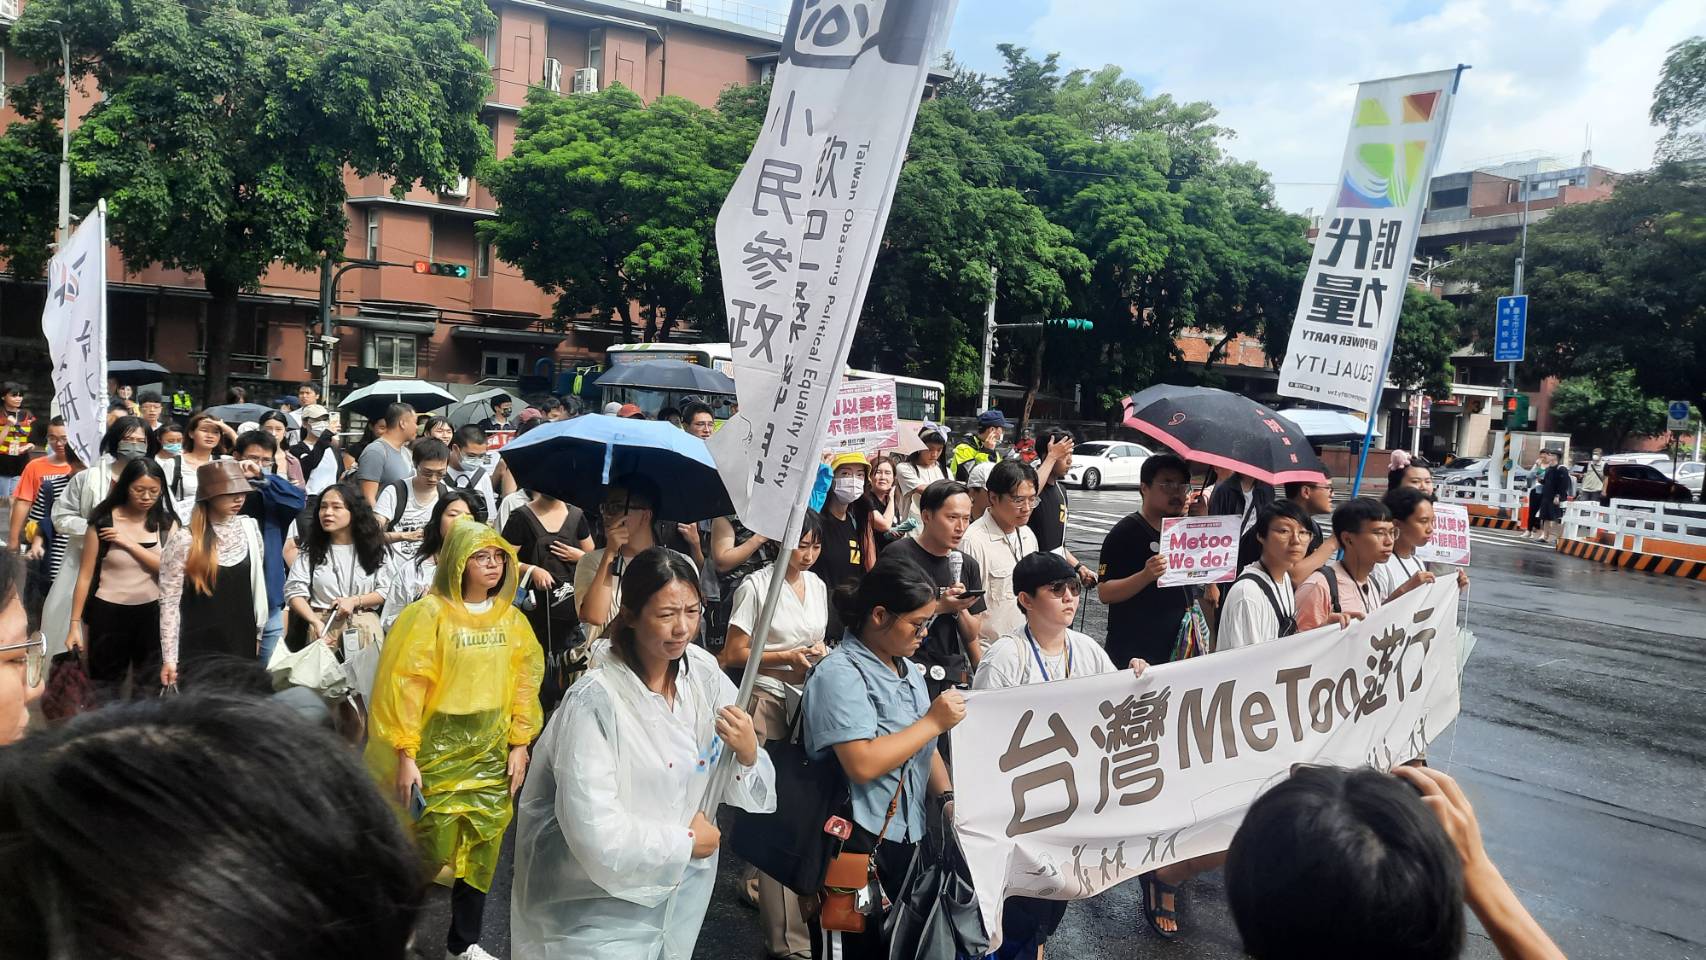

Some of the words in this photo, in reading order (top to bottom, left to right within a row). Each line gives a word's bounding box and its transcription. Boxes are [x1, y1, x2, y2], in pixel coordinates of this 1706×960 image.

[848, 140, 872, 201] Taiwan
[731, 89, 814, 363] 小民參政
[829, 208, 854, 286] Obasang
[807, 295, 836, 362] Political
[786, 368, 819, 439] Equality
[773, 444, 799, 489] Party
[1169, 532, 1233, 551] Metoo
[1169, 553, 1195, 569] We
[1200, 551, 1229, 567] do!
